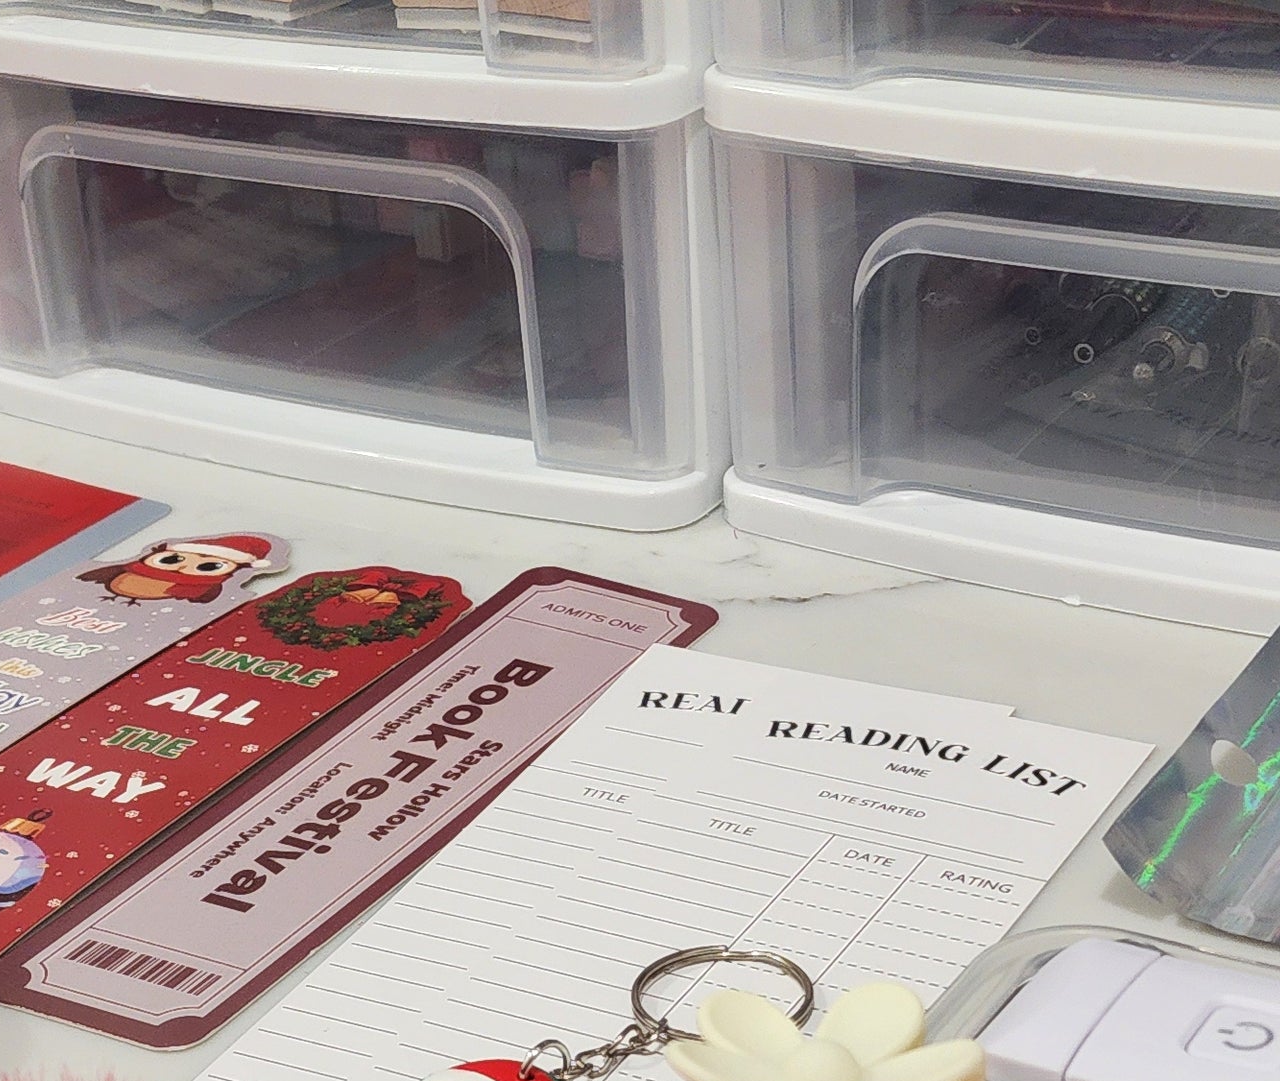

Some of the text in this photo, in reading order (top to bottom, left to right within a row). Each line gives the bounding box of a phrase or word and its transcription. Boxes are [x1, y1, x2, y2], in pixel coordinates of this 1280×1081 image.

[36, 606, 128, 635] Best
[541, 603, 650, 635] ADMITS ONE
[186, 647, 339, 688] JINGLE
[146, 686, 262, 727] ALL
[371, 663, 482, 741] Time: Midnight
[106, 724, 199, 760] THE
[766, 720, 1087, 797] READING LIST
[25, 757, 167, 804] WAY
[200, 657, 554, 913] Book Festival
[885, 762, 931, 778] NAME
[365, 737, 504, 842] Stars Hollow
[582, 786, 630, 804] TITLE
[818, 790, 926, 819] DATE STARTED
[189, 760, 354, 880] Location: Anywhere
[708, 818, 758, 837] TITLE
[843, 849, 896, 868] DATE
[940, 870, 1014, 895] RATING
